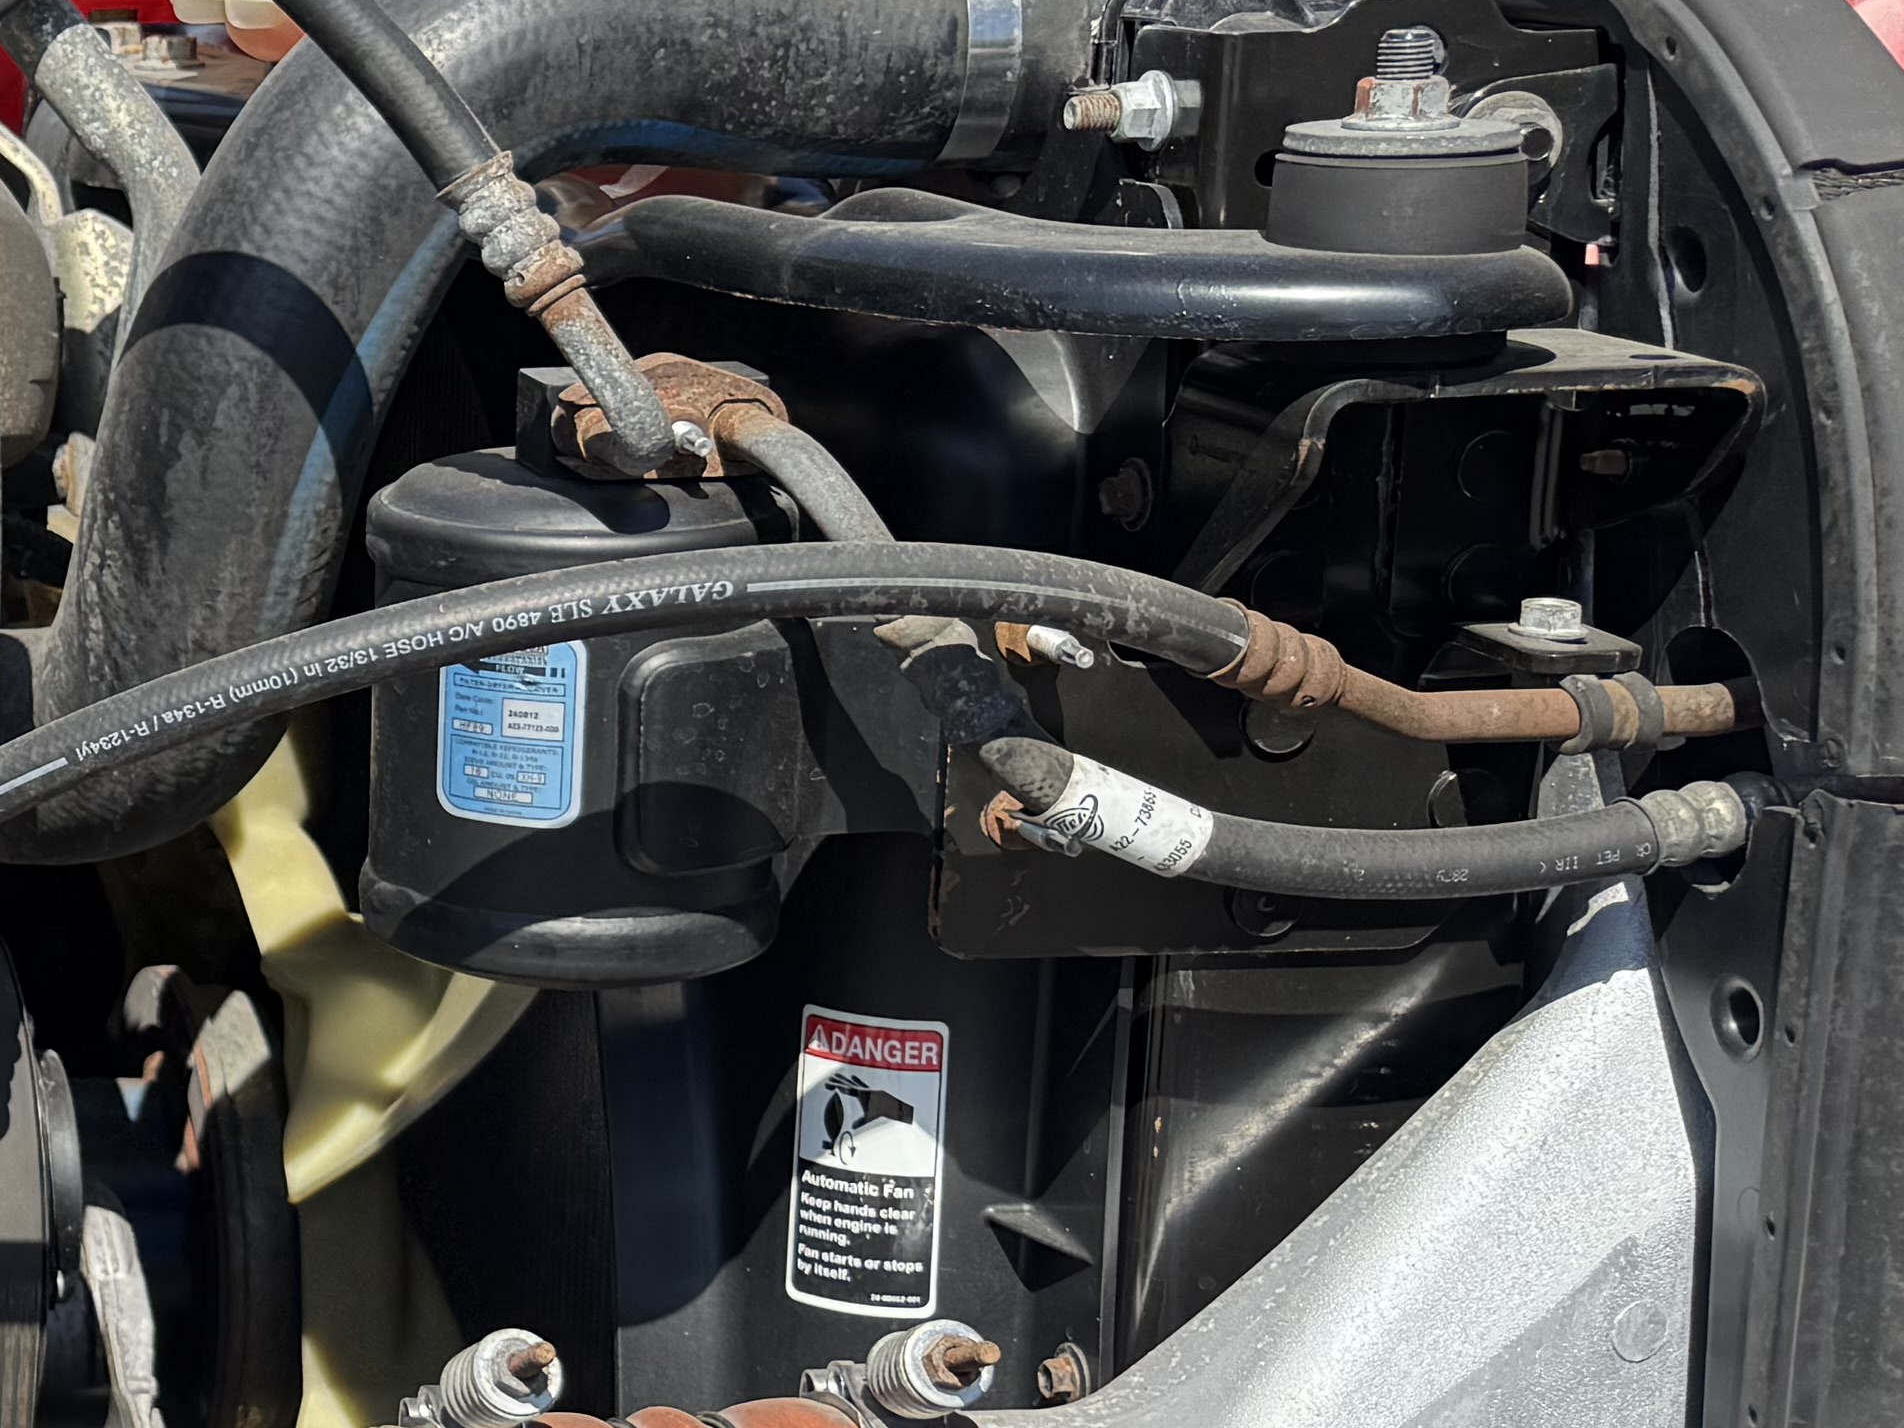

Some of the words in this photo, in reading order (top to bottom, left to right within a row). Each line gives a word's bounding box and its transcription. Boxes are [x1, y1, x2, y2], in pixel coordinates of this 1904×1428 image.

[604, 577, 735, 614] GALAXY
[492, 610, 542, 633] 4890
[549, 599, 592, 623] SLE
[448, 622, 483, 645] A/C
[385, 634, 444, 660] HOSE
[302, 662, 323, 678] in
[324, 647, 380, 673] 13/32
[495, 664, 525, 674] FLOW
[230, 674, 298, 702] (10mm)
[163, 693, 226, 724] R-134a
[153, 713, 161, 731] /
[486, 790, 519, 801] NONE
[1555, 856, 1579, 871] IIR
[1595, 850, 1620, 866] PET
[831, 1030, 938, 1065] DANGER
[801, 1170, 879, 1197] Automatic
[883, 1178, 915, 1199] Fan
[801, 1192, 831, 1212] Keep
[833, 1199, 876, 1217] hands
[879, 1205, 915, 1221] clear
[800, 1209, 832, 1226] when
[834, 1215, 881, 1235] engine
[885, 1222, 898, 1235] is
[799, 1225, 850, 1247] running.
[798, 1244, 819, 1260] Fan
[822, 1251, 862, 1269] starts
[865, 1258, 881, 1271] or
[884, 1260, 923, 1274] stops
[798, 1258, 813, 1276] by
[815, 1262, 851, 1281] itself.
